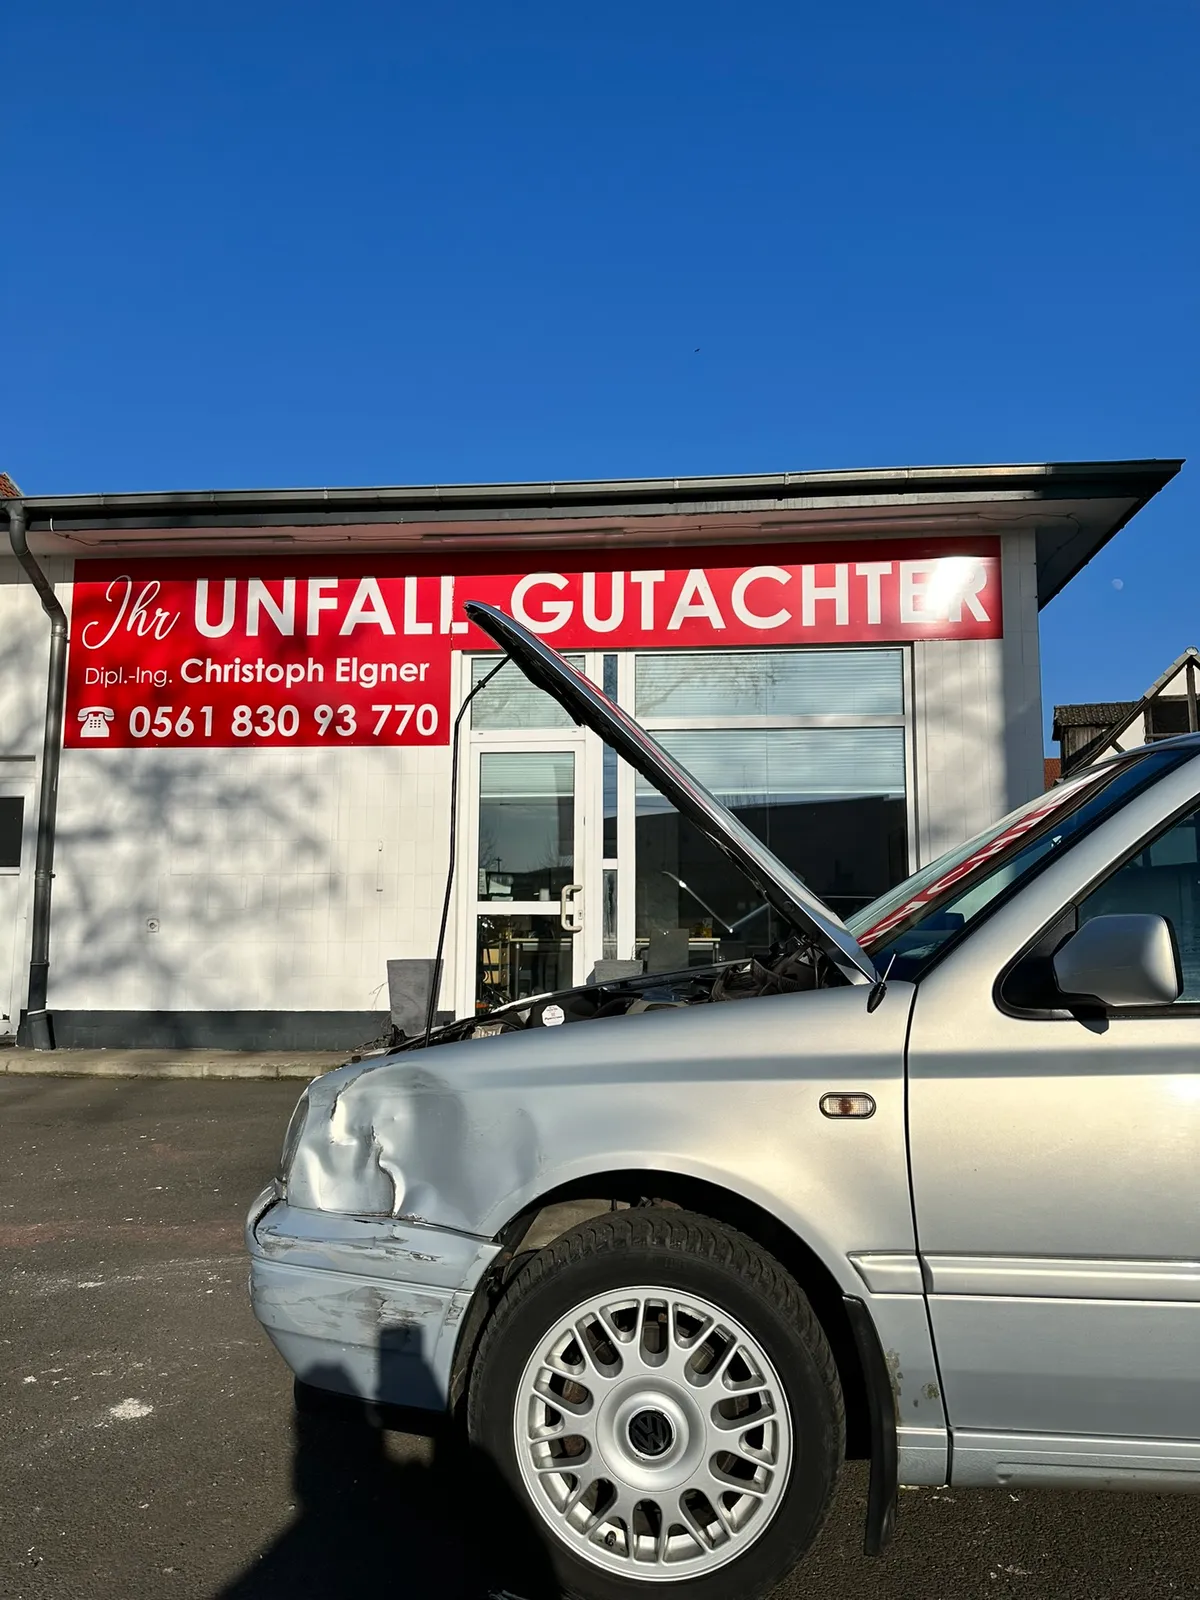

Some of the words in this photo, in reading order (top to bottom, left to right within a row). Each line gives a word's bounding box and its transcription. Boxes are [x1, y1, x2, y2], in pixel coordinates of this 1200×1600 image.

[82, 574, 181, 650] Ihr
[85, 666, 173, 688] Dipl.-Ing.
[180, 657, 324, 688] Christoph
[335, 657, 430, 688] Elgner
[129, 705, 213, 738] 0561
[231, 704, 299, 737] 830
[313, 703, 357, 736] 93
[372, 703, 439, 736] 770
